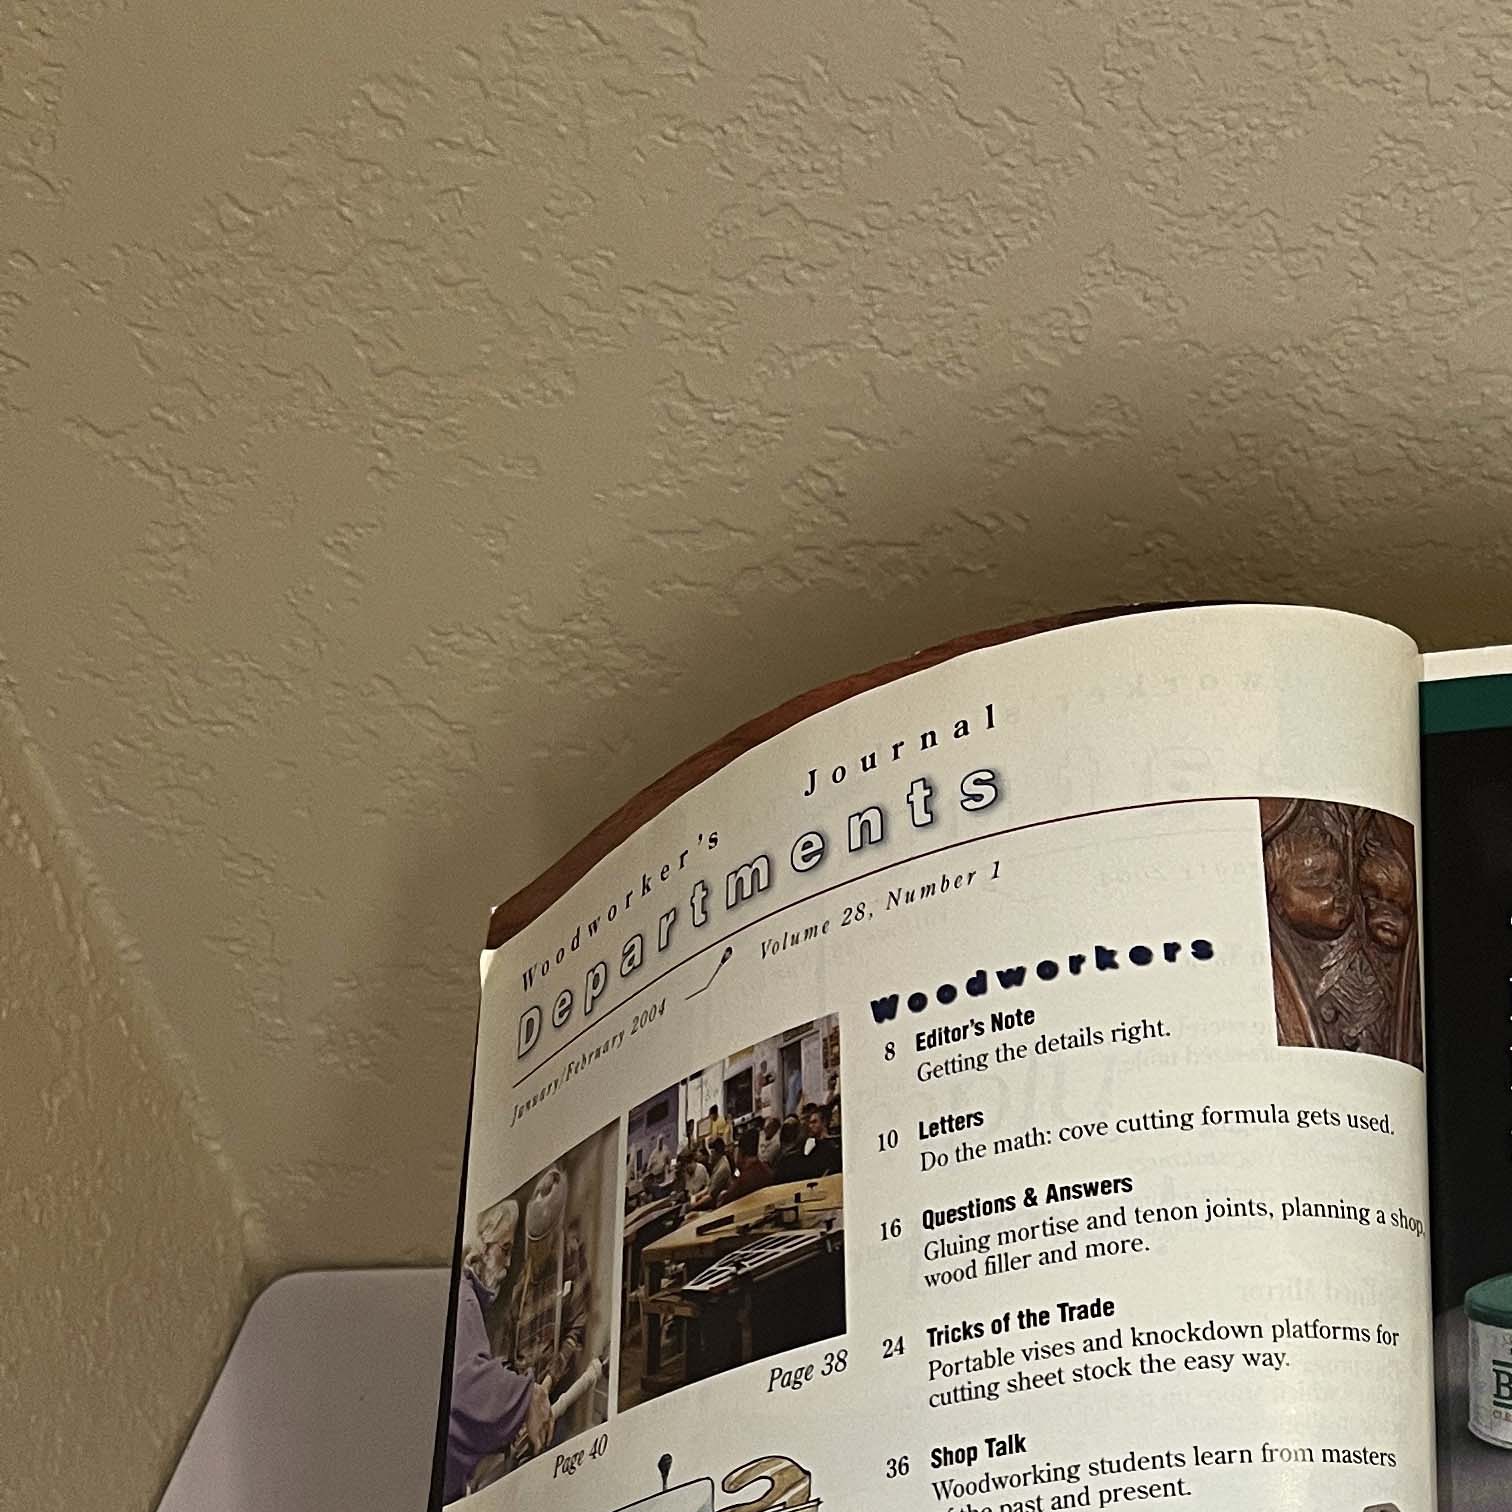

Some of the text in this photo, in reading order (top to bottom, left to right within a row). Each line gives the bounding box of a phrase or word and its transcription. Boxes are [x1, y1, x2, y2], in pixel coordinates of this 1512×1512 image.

[522, 703, 996, 992] Woodworker's Journal
[516, 768, 999, 1059] Departments
[760, 859, 1001, 961] Volume 28, Number 1
[871, 938, 1214, 1024] Woodworkers
[511, 998, 668, 1127] January/February 2004
[884, 1008, 1036, 1062] 8 Editor's Note
[916, 1018, 1171, 1083] Getting the details right.
[877, 1110, 985, 1153] 10 Letters
[880, 1176, 1134, 1242] 16 Questions & Answers
[882, 1297, 1115, 1360] 24 Tricks of the Trade
[766, 1348, 849, 1393] Page 38
[552, 1433, 609, 1480] Page 40
[885, 1432, 1028, 1479] 36 Shop Talk
